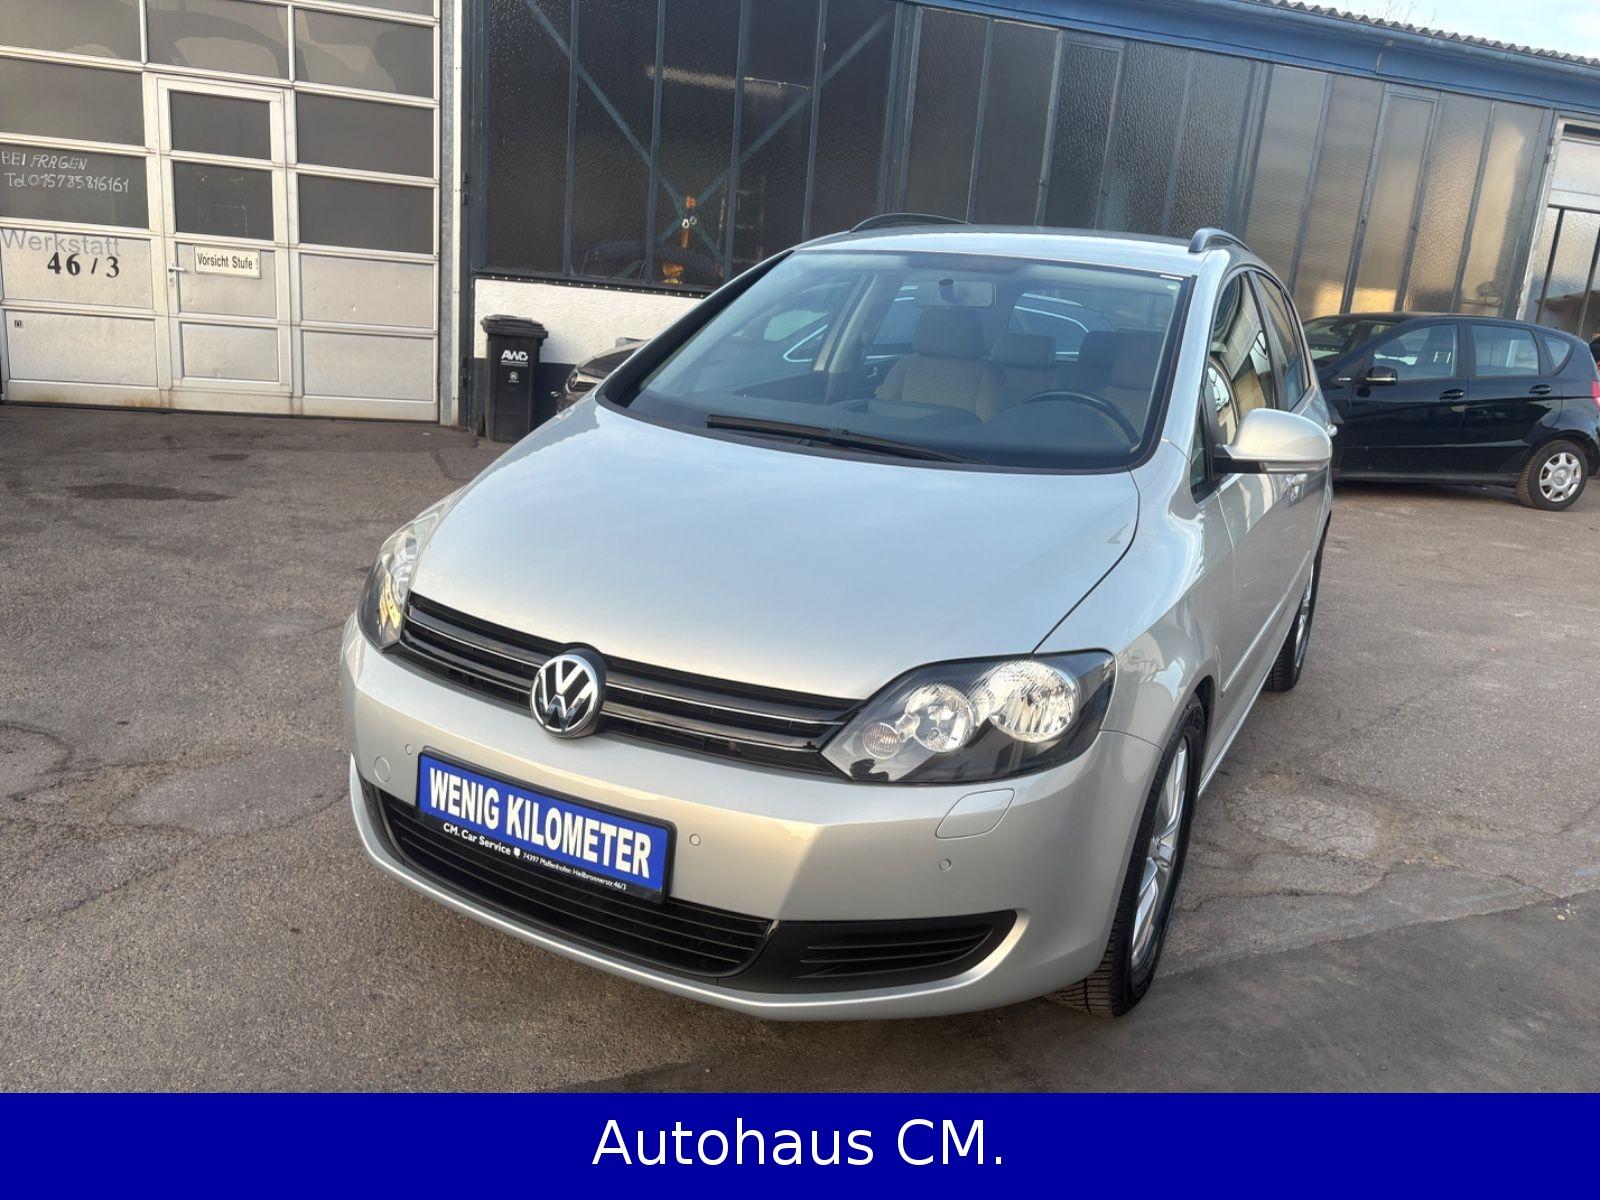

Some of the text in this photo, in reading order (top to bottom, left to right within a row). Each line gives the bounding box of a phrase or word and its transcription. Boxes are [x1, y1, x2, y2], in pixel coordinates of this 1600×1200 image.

[1, 151, 88, 170] BEI FRAGEN
[1, 229, 121, 256] Werkstatt
[197, 253, 229, 268] Vorsicht
[430, 767, 652, 879] WENIG KILOMETER
[443, 822, 460, 837] CM.
[461, 829, 478, 843] Car
[479, 835, 511, 856] Service
